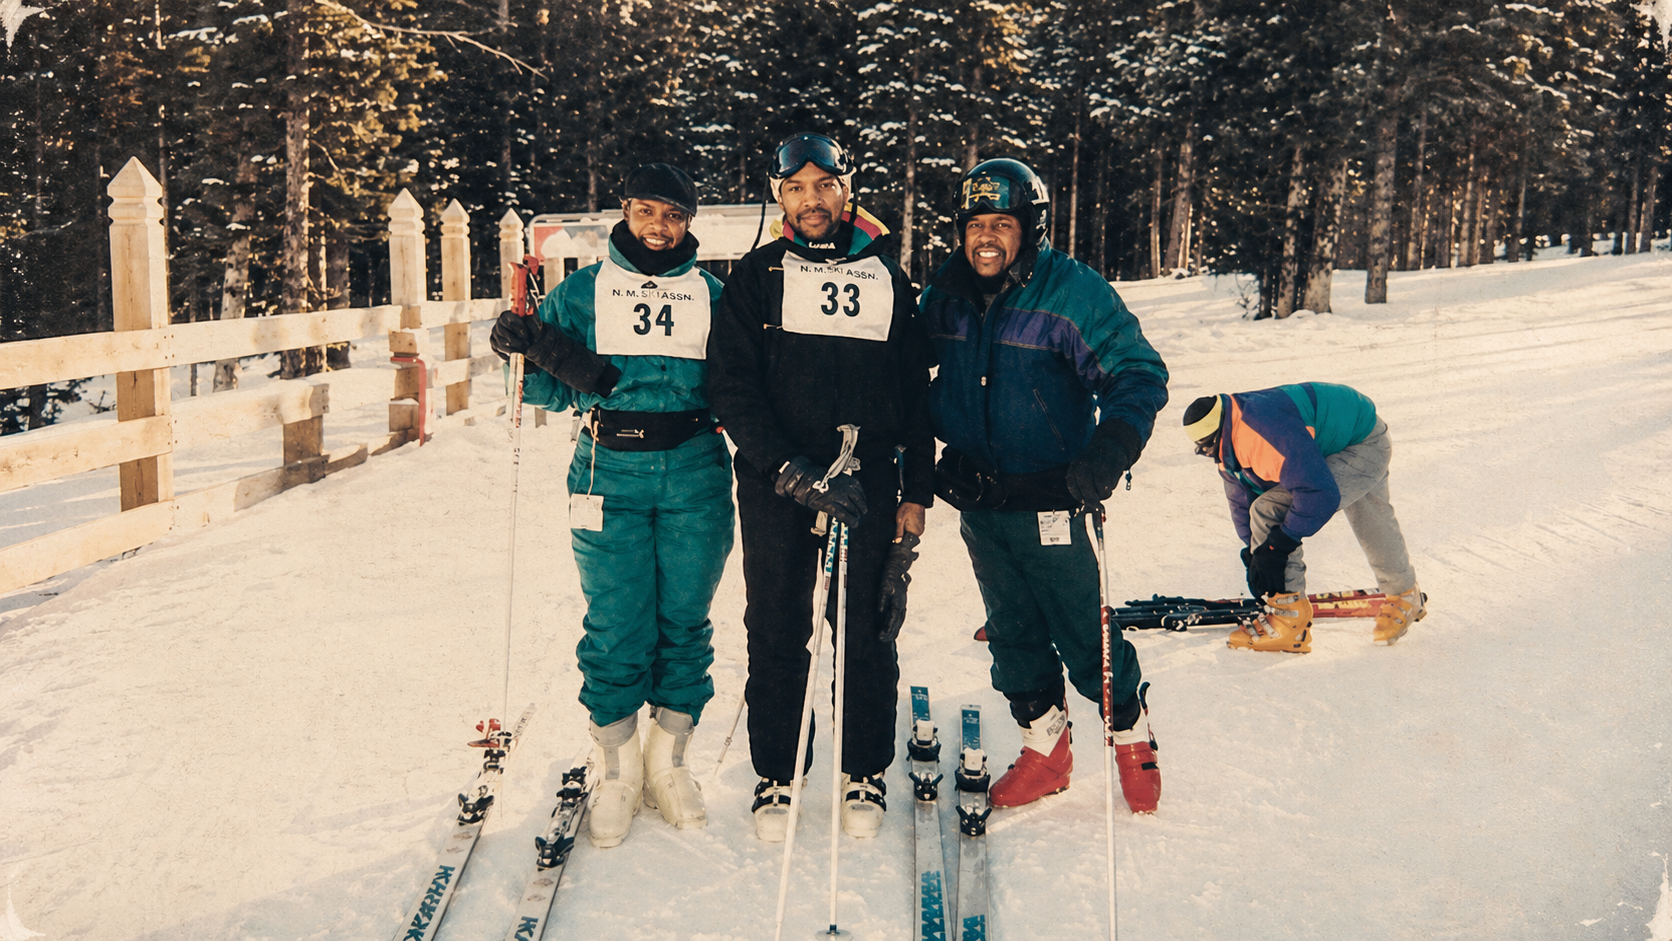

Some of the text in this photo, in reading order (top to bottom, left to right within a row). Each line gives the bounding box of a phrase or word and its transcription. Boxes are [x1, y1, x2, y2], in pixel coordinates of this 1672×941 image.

[800, 265, 812, 273] N.
[846, 269, 879, 280] ASSN.
[613, 289, 694, 301] N. M. SKI ASSN.
[821, 282, 860, 317] 33
[633, 303, 674, 336] 34
